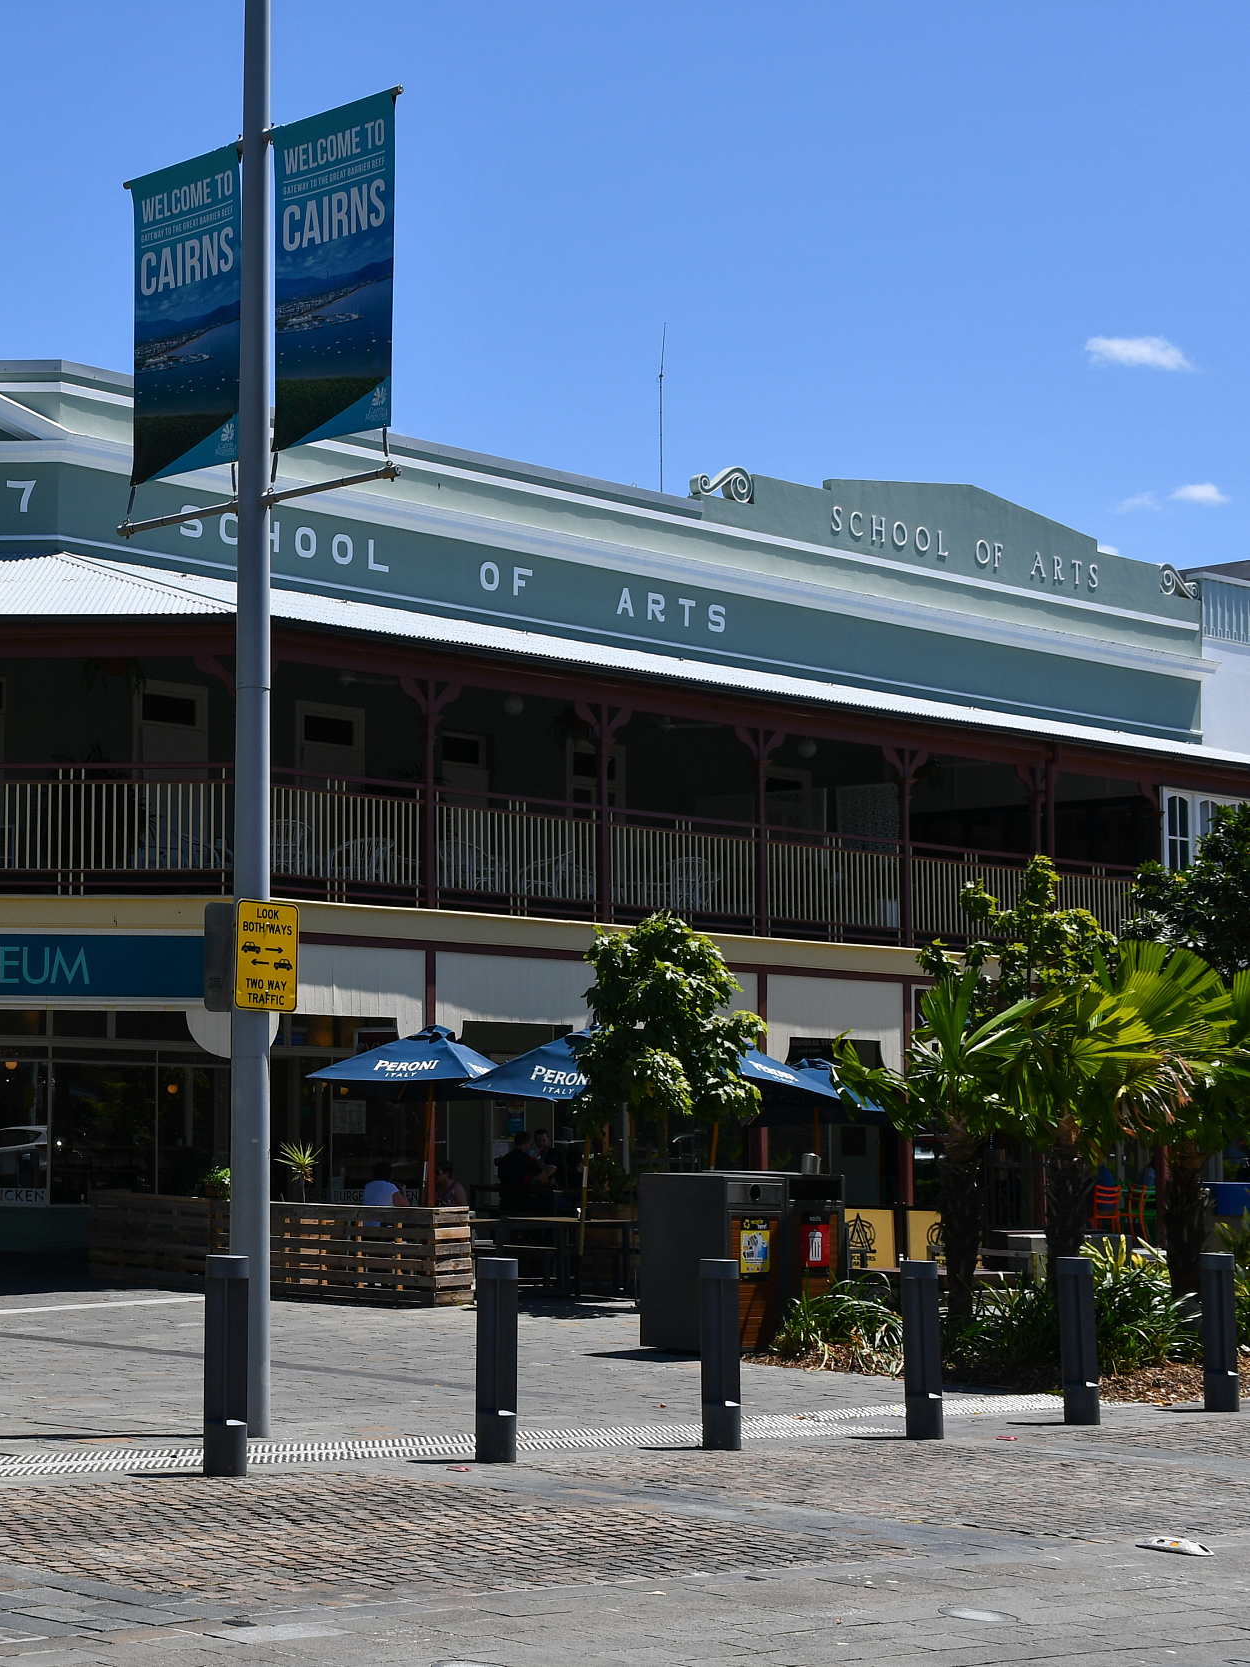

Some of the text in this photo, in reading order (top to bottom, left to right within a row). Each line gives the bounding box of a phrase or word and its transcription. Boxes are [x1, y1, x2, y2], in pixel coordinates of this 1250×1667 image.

[283, 118, 385, 175] WELCOME TO
[283, 156, 385, 196] GATEWAY TO THE GREAT BARRIER REEF
[141, 170, 233, 224] WELCOME TO
[283, 178, 386, 251] CAIRNS
[141, 205, 233, 243] GATEWAY TO THE GREAT BARRIER REEF
[140, 226, 234, 296] CAIRNS
[830, 505, 1099, 589] SCHOOL OF ARTS
[179, 504, 727, 633] SCHOOL OF ARTS
[243, 921, 293, 936] BOTH WAYS
[257, 908, 279, 920] LOOK
[246, 978, 287, 991] TWO WAY
[247, 993, 285, 1006] TRAFFIC
[372, 1059, 440, 1072] PERONI
[542, 1086, 575, 1095] ITALY
[334, 1189, 364, 1201] BURGE
